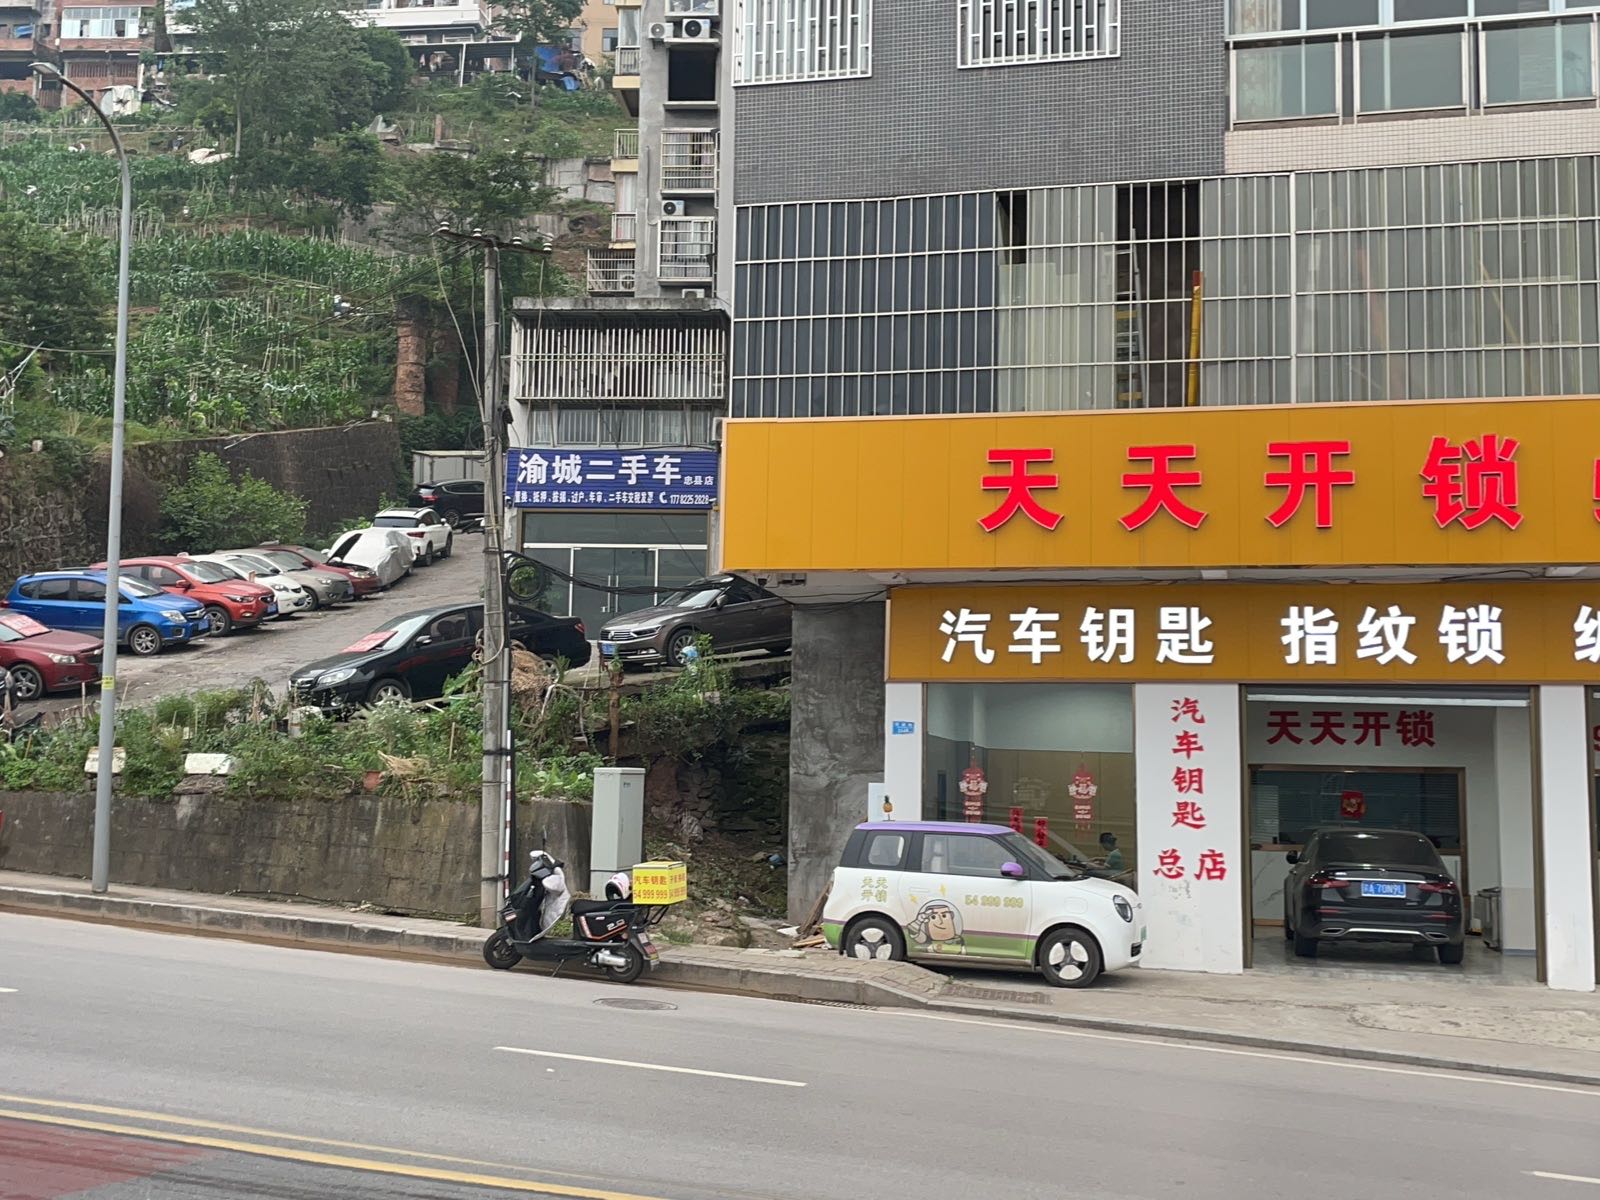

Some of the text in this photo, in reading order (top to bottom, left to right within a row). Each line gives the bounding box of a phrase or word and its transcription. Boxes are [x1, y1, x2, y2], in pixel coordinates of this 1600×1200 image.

[517, 453, 715, 487] 渝城二手车 忠县店
[981, 434, 1600, 532] 天天开锁
[940, 607, 1215, 665] 汽车钥匙
[1281, 605, 1506, 666] 指纹锁
[1266, 710, 1436, 747] 天天开锁
[1171, 697, 1206, 829] 汽车钥匙
[634, 875, 668, 886] 汽车钥匙
[1153, 848, 1227, 881] 总店
[861, 876, 889, 889] 天天
[861, 889, 888, 903] 开锁
